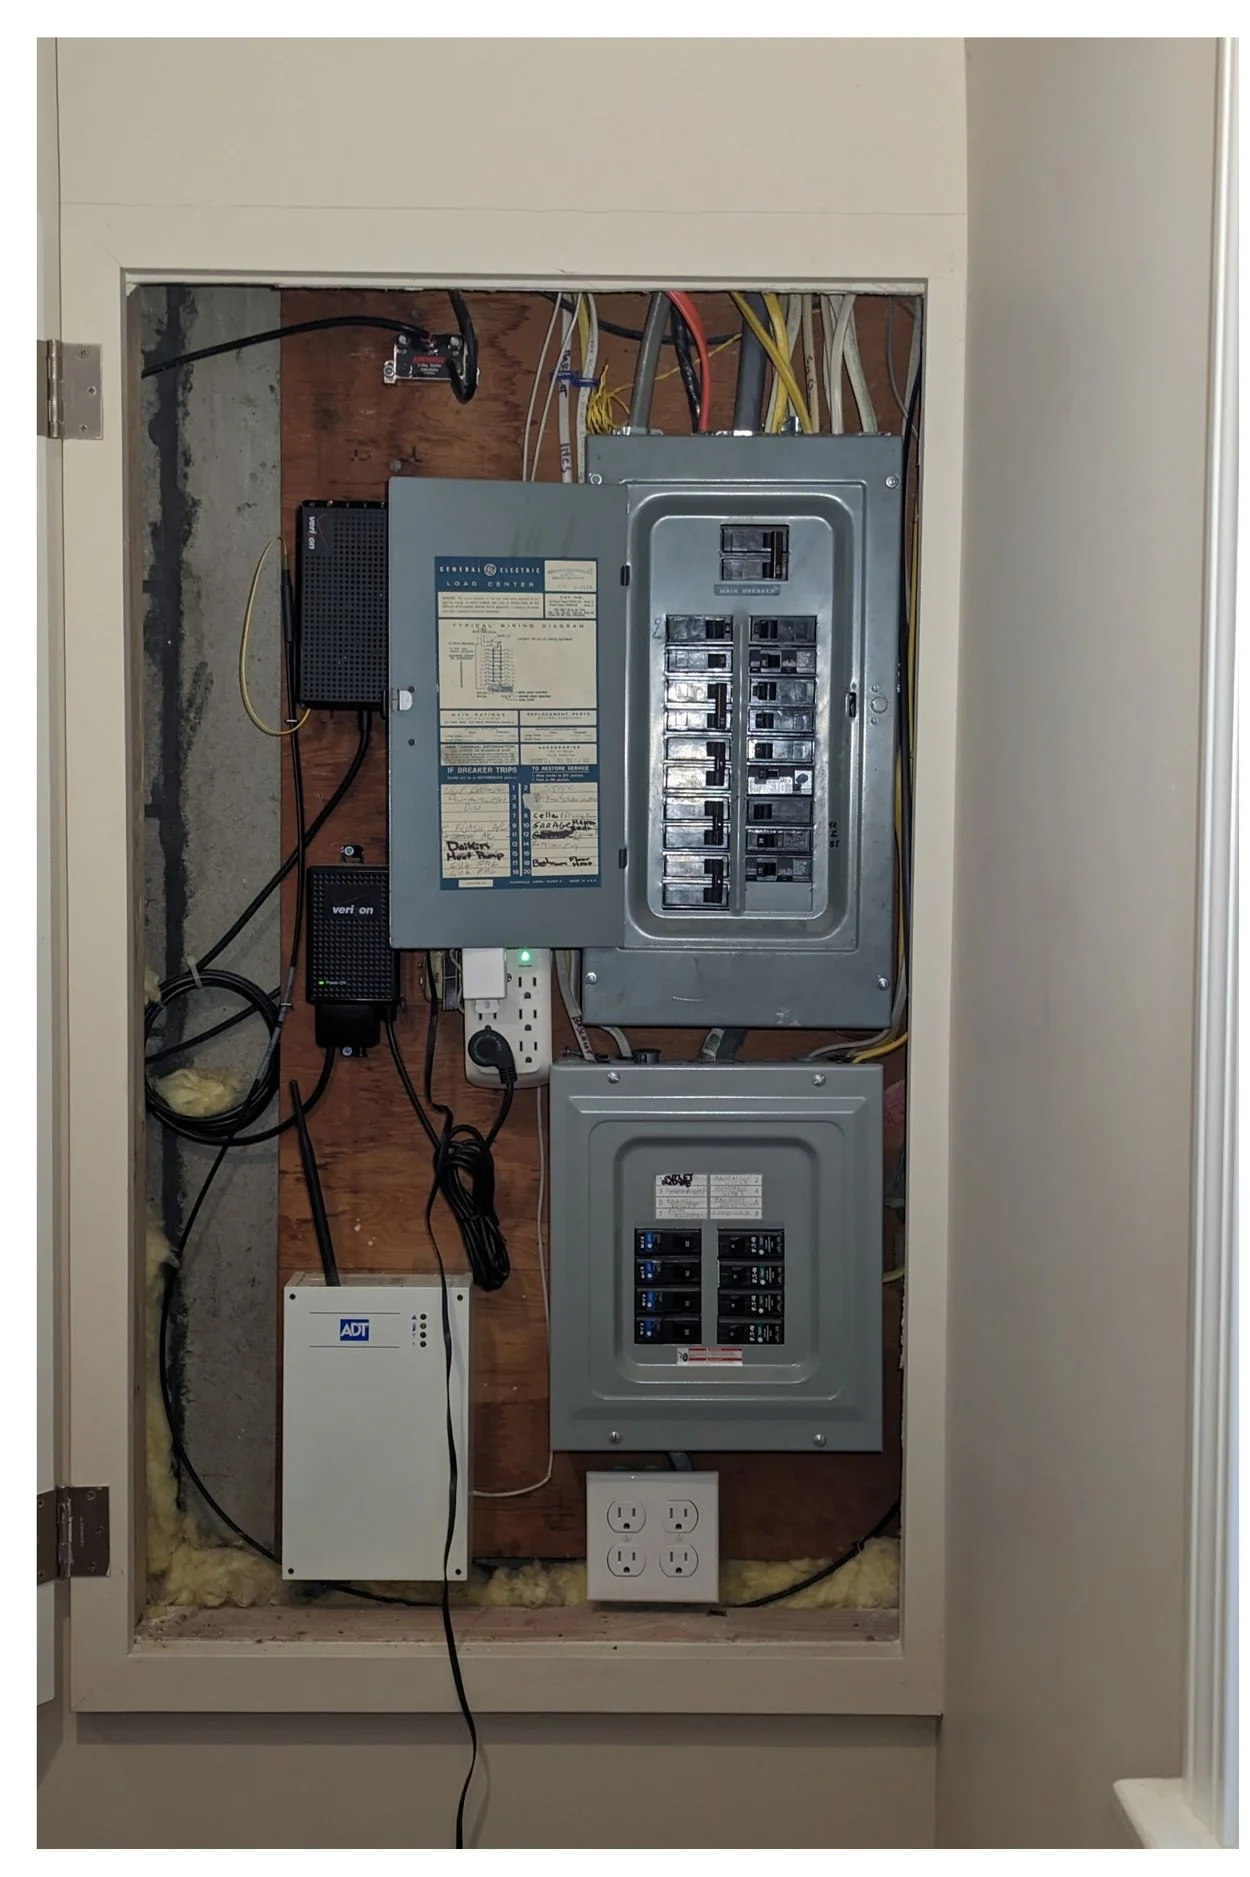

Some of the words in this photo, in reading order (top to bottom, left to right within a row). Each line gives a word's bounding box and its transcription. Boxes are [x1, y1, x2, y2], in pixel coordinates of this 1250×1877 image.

[445, 841, 491, 851] Daikin
[477, 851, 505, 862] Pump
[340, 1322, 369, 1337] ADT
